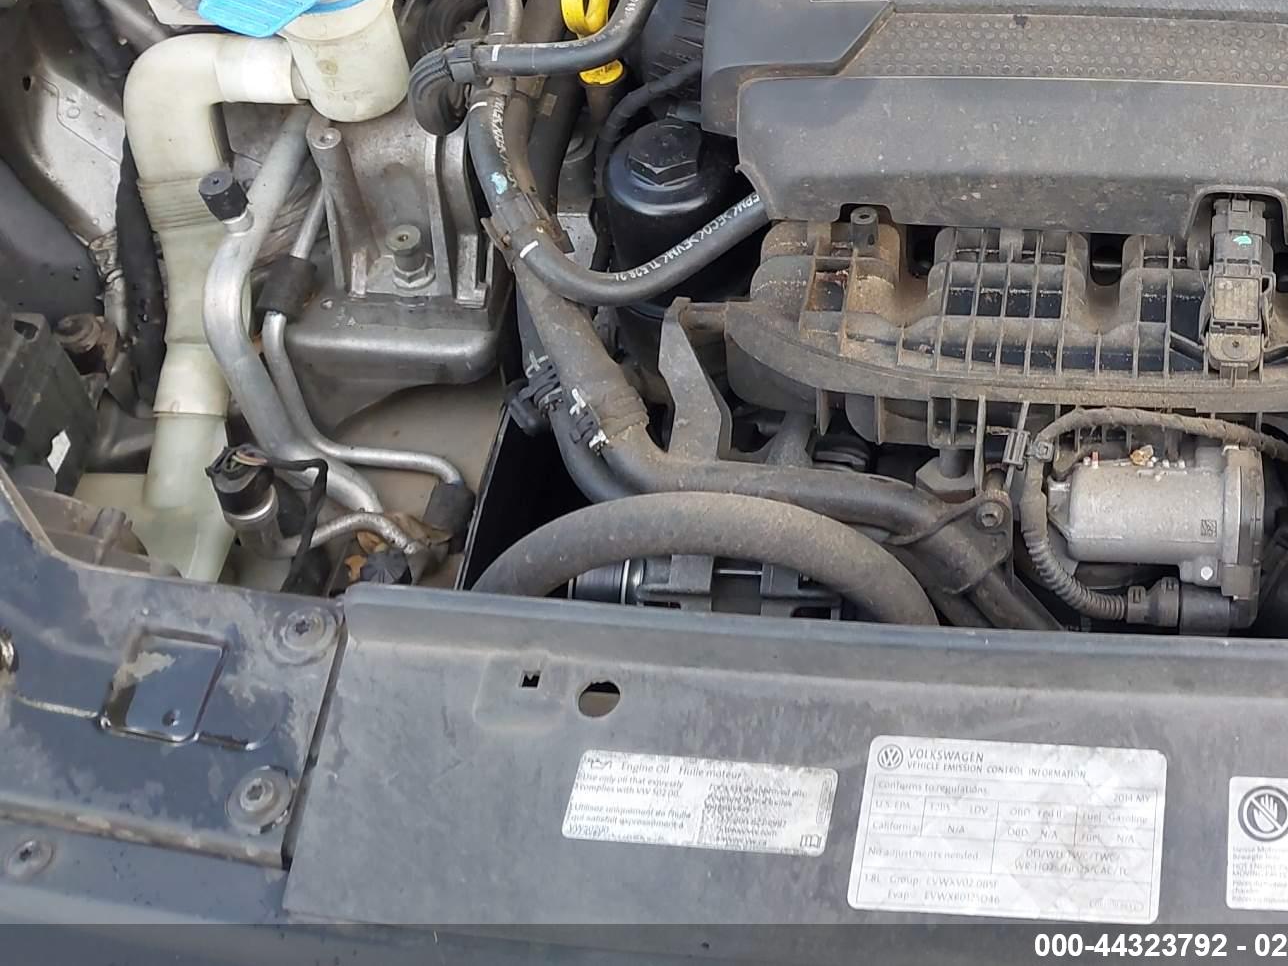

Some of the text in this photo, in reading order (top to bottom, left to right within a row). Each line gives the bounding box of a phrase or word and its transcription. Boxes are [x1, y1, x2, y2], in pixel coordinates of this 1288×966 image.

[909, 748, 984, 762] VOLKSWAGEN
[622, 761, 654, 773] Engine
[656, 764, 670, 774] Oil
[706, 769, 742, 779] moteur
[908, 761, 1087, 779] VEHICLE EMISSION CONTROL INFORMATION
[878, 778, 922, 790] Conforms
[969, 804, 988, 815] LDV
[948, 825, 966, 834] N/A
[1040, 828, 1058, 839] N/A
[1117, 834, 1136, 843] N/A
